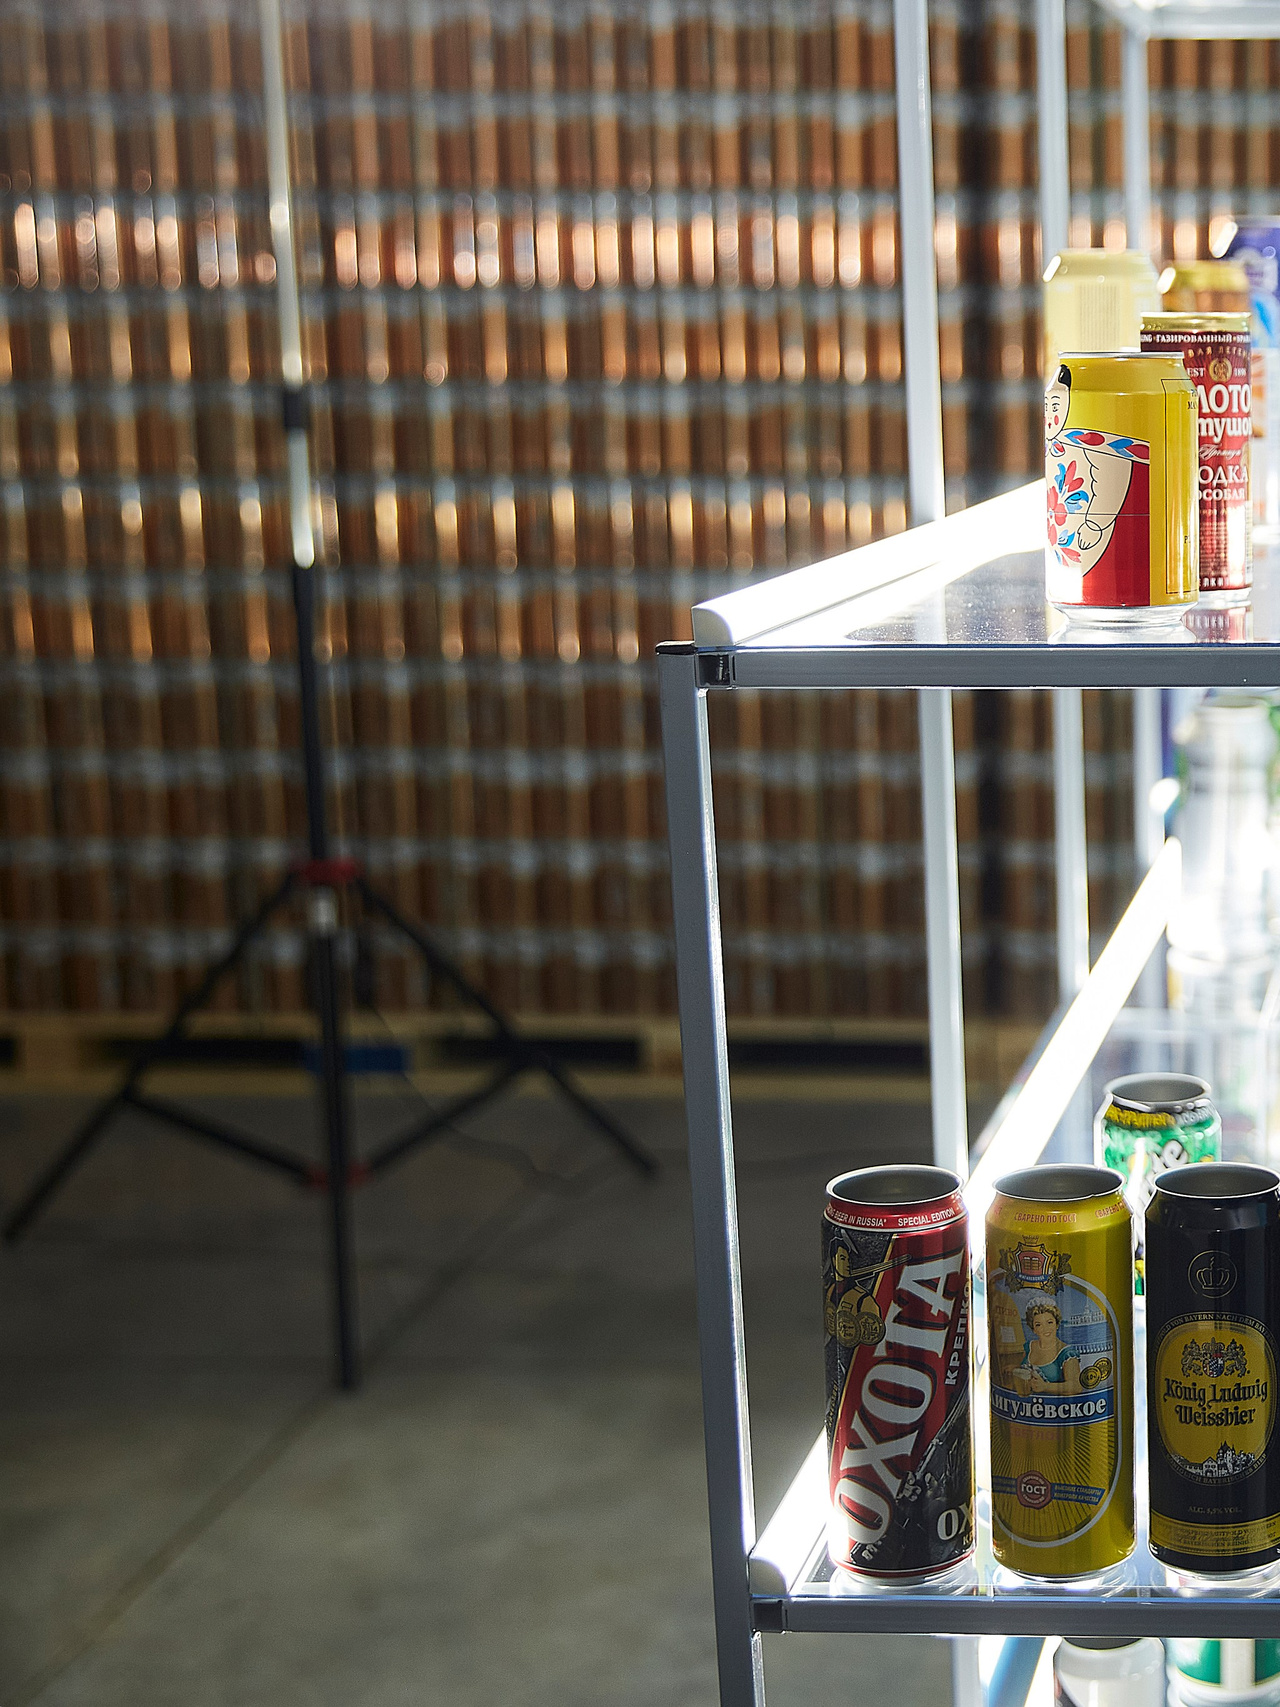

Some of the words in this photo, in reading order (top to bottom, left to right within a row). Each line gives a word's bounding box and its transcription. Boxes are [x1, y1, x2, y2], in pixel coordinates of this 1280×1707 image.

[1156, 333, 1232, 343] ГАЗИРОВАННЫЙ
[1187, 367, 1205, 377] EST
[1197, 384, 1251, 414] ЛОТО
[1198, 417, 1252, 443] тушо
[1198, 465, 1249, 488] ОДКА
[834, 1210, 849, 1223] BEER
[898, 1214, 931, 1227] SPECIAL
[931, 1207, 955, 1223] EDITION
[1014, 1212, 1045, 1223] СВАРЕНО
[1046, 1214, 1057, 1224] ПО
[1059, 1212, 1077, 1223] ГОСТ
[1095, 1204, 1120, 1219] СВАРЕНО
[1185, 1313, 1214, 1324] BAYERN
[1216, 1313, 1237, 1321] NACH
[944, 1281, 972, 1386] КРЕПКО
[834, 1250, 965, 1545] ОХОТА
[1162, 1377, 1206, 1407] König
[1206, 1378, 1268, 1409] Ludwig
[1174, 1404, 1256, 1427] Weissbier
[1021, 1483, 1047, 1495] ГОСТ
[1188, 1506, 1206, 1514] ALC.
